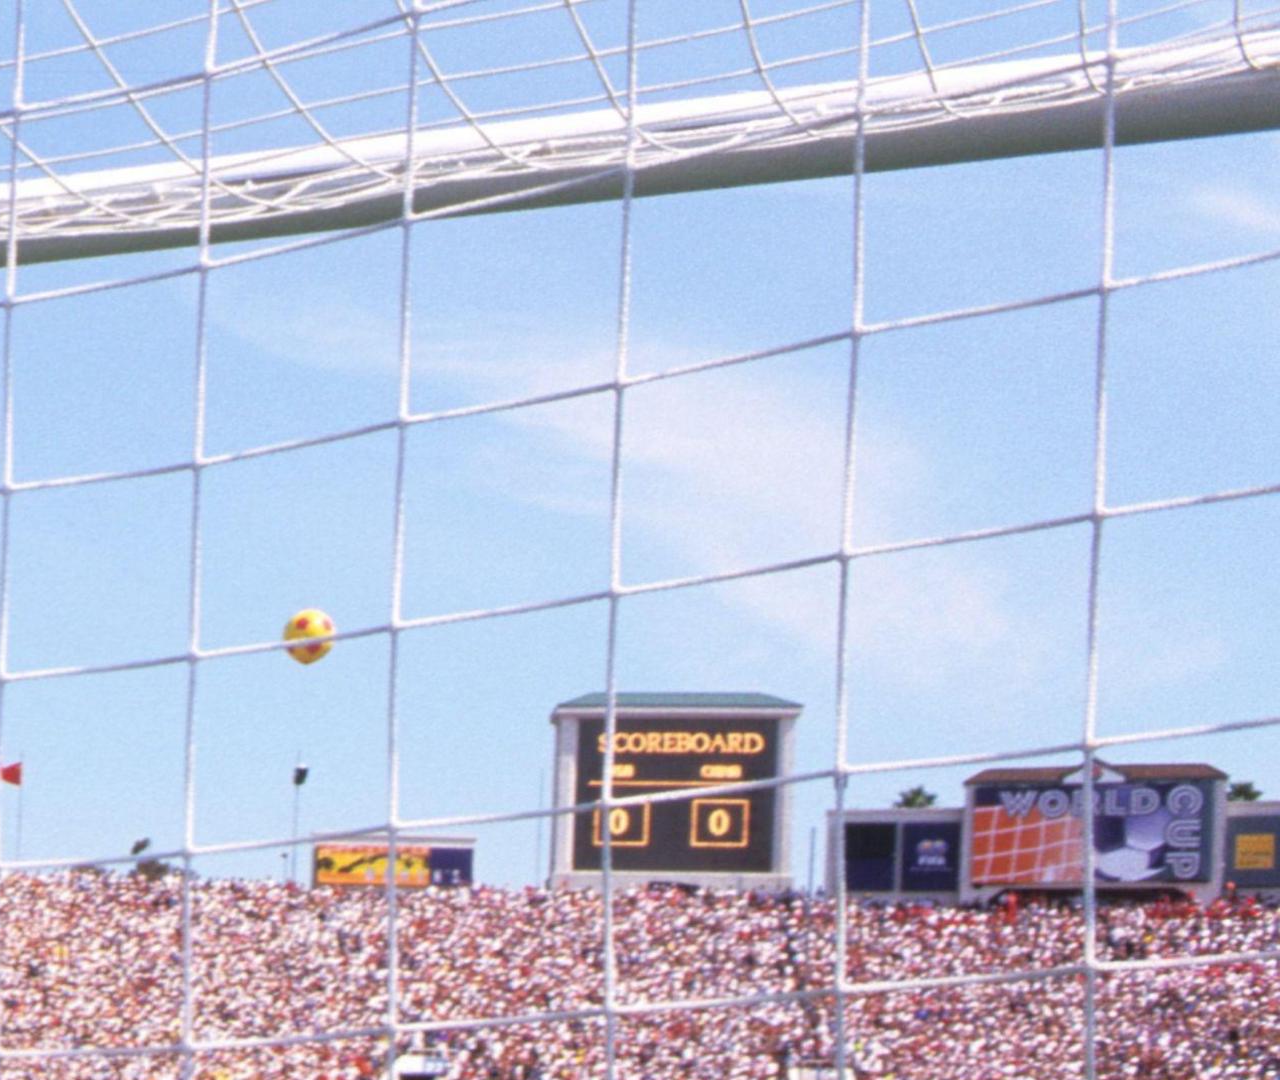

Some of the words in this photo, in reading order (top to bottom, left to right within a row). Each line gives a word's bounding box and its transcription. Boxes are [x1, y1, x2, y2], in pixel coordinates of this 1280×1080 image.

[598, 732, 766, 755] SCOREBOARD
[999, 786, 1160, 818] WORLD
[607, 808, 630, 836] 0
[708, 808, 731, 837] 0
[1165, 784, 1202, 880] CUP
